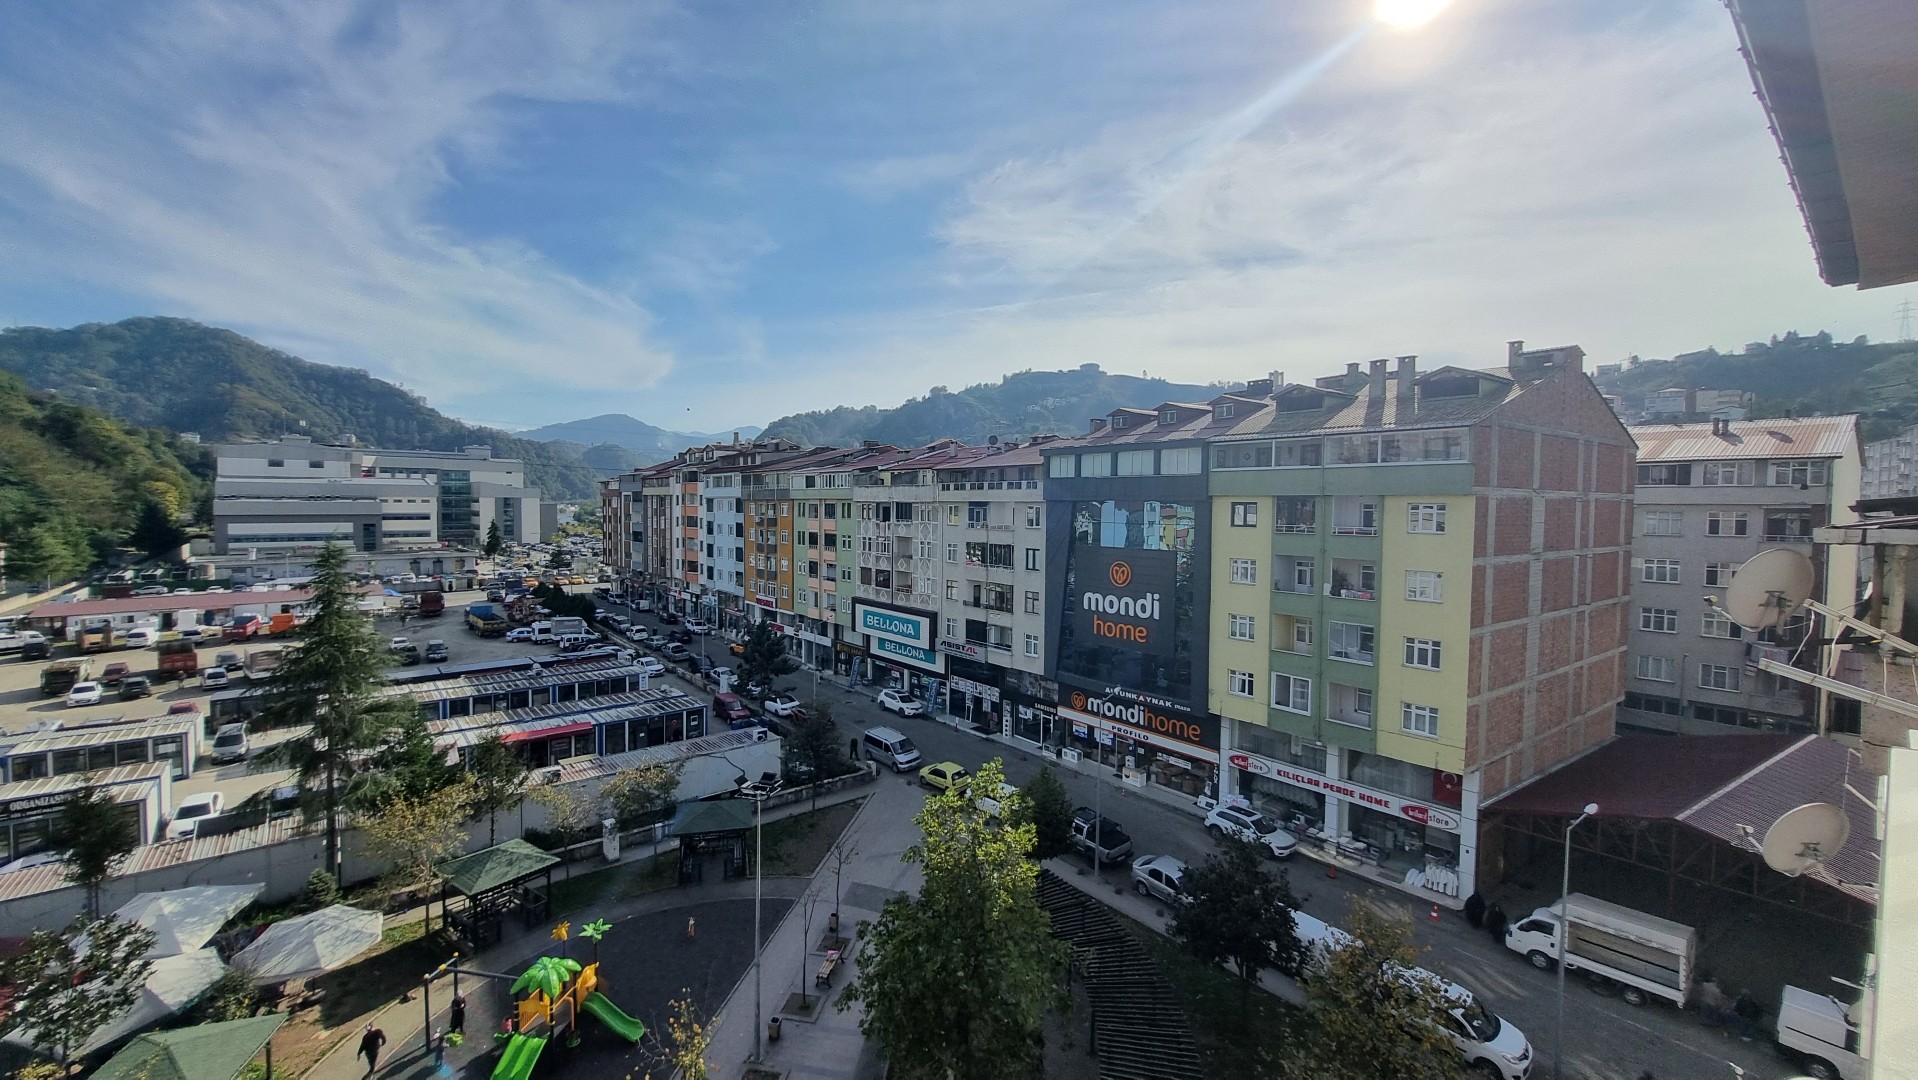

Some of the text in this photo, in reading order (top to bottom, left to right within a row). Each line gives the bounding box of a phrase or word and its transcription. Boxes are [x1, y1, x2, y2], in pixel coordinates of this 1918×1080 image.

[1083, 592, 1160, 620] mondi
[866, 614, 915, 636] BELLONA
[1093, 614, 1148, 643] home
[884, 641, 925, 660] BELLONA
[940, 640, 978, 655] ASISTAL
[1034, 702, 1057, 714] SAMSUNG
[1087, 697, 1201, 741] mondihome
[1276, 768, 1391, 809] KILIÇLAR PERDE HOME
[1428, 814, 1449, 827] store
